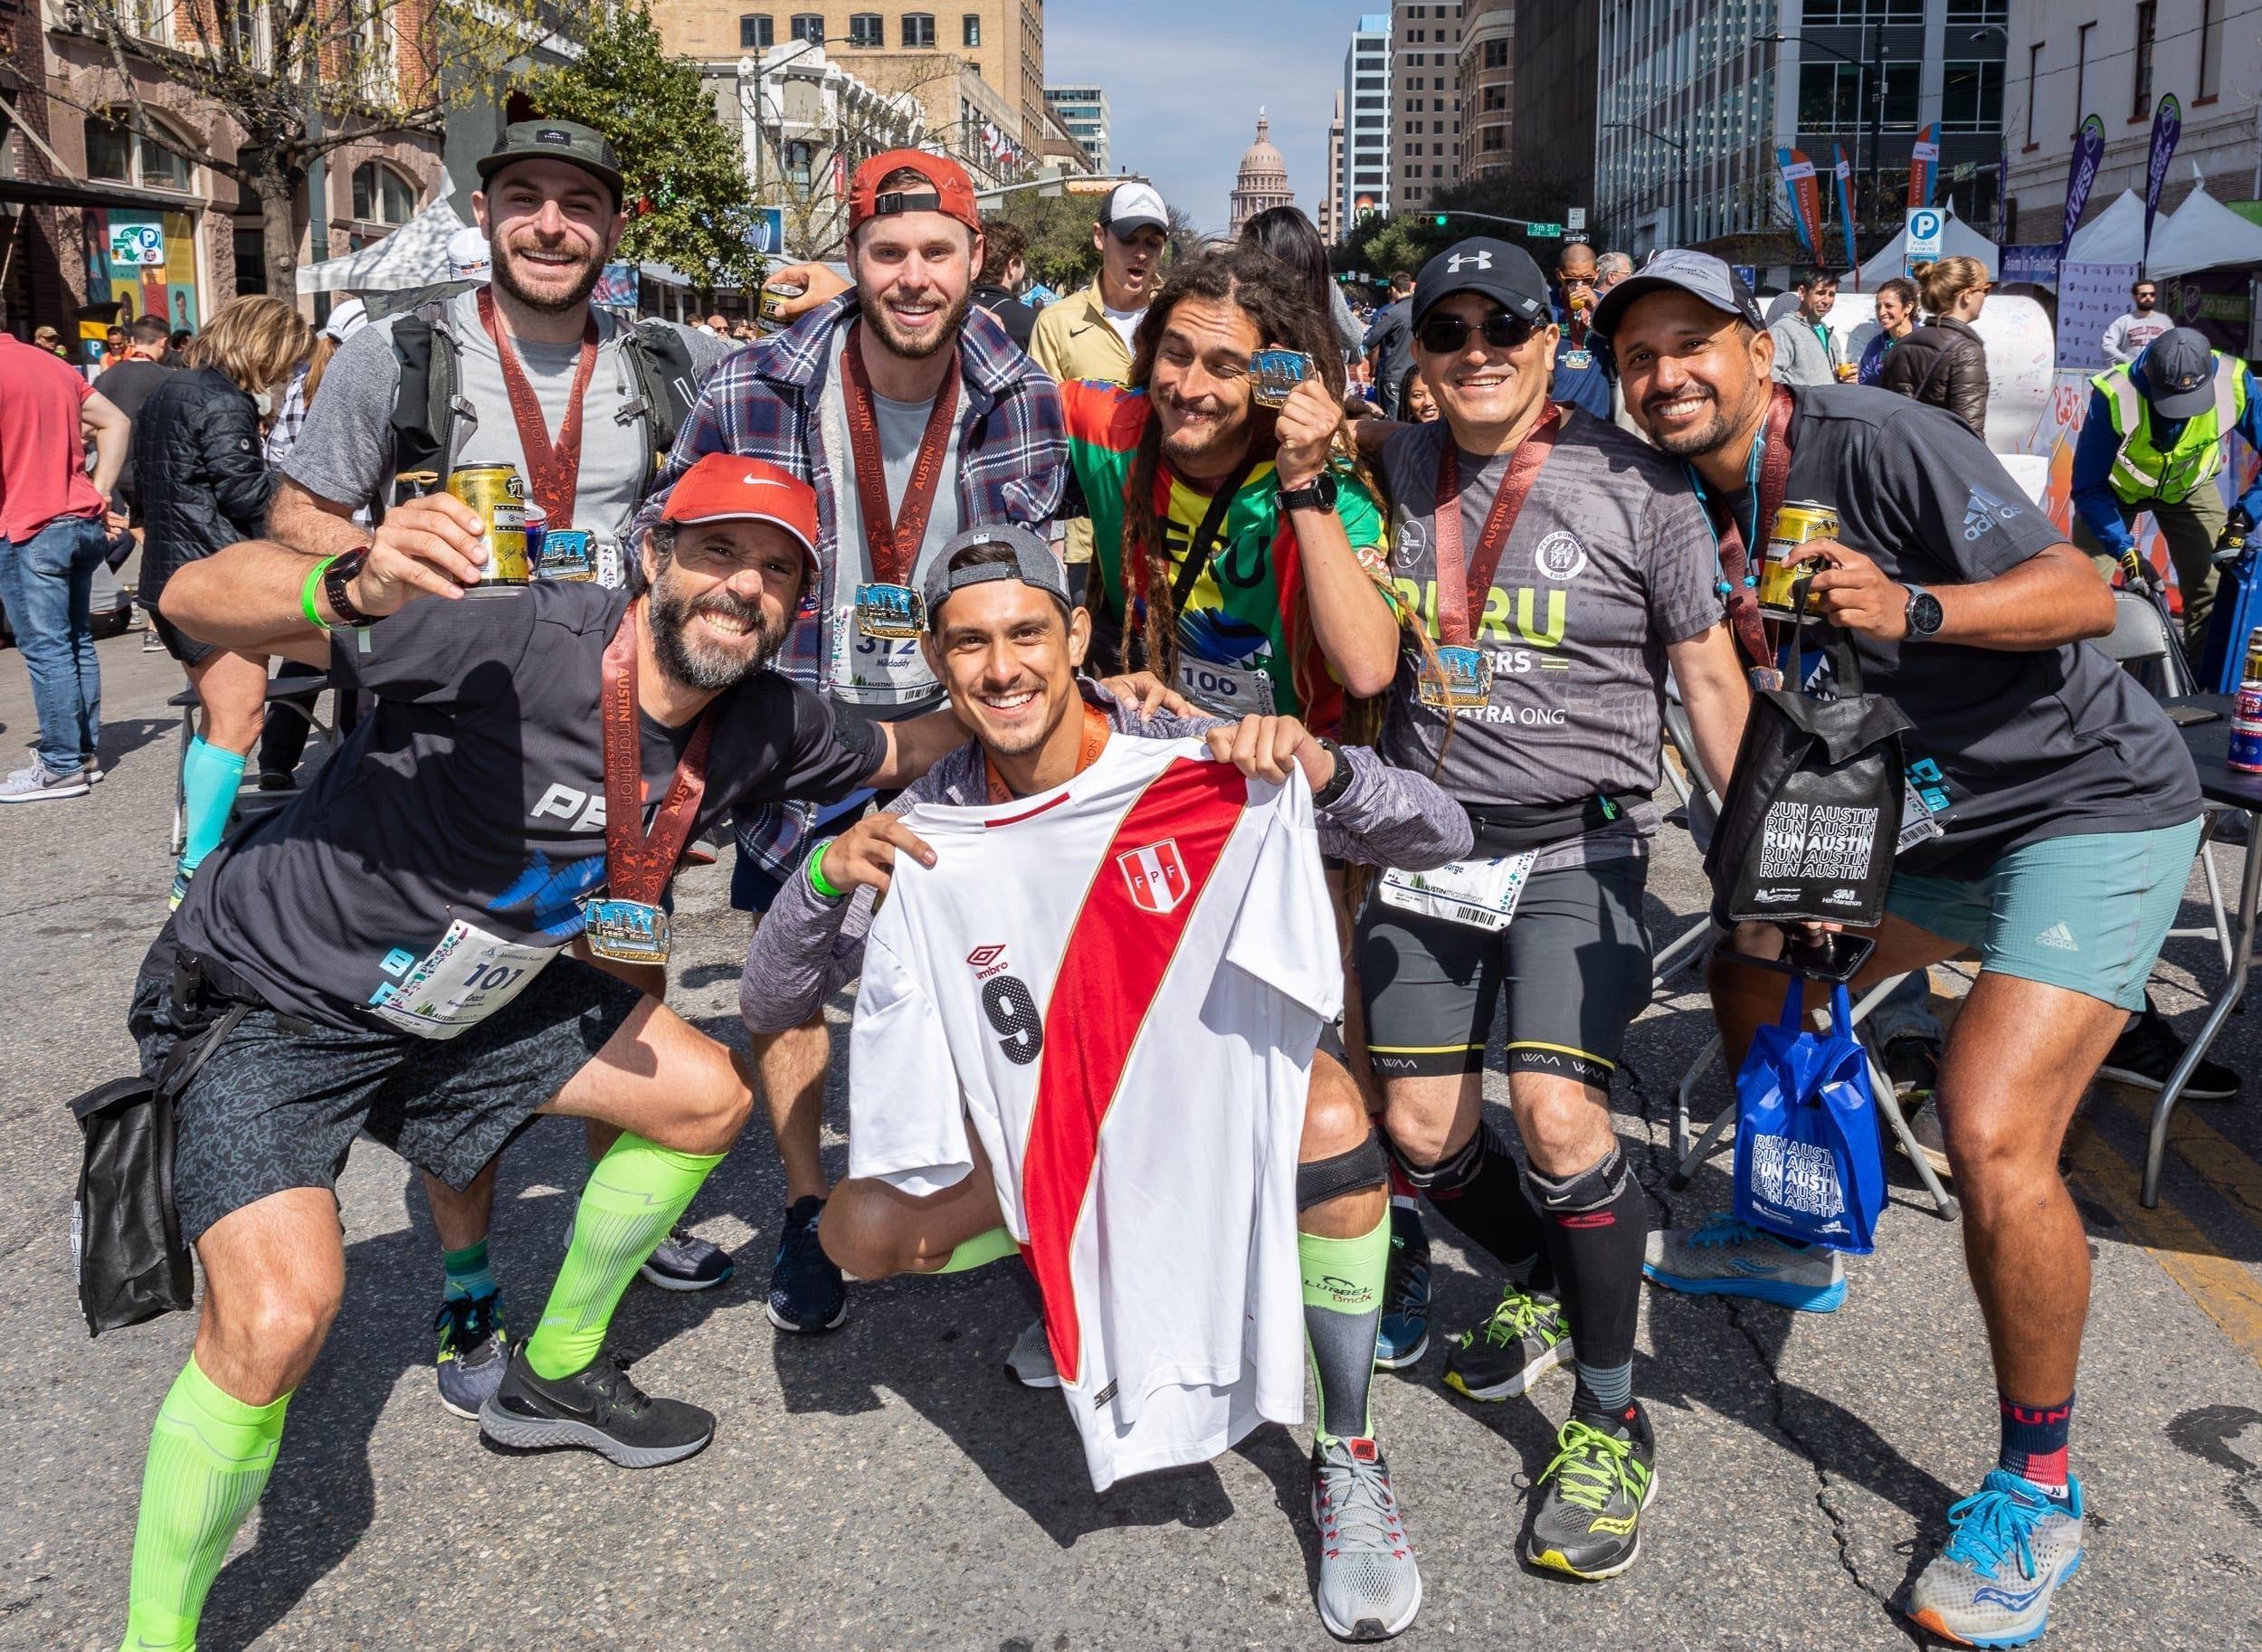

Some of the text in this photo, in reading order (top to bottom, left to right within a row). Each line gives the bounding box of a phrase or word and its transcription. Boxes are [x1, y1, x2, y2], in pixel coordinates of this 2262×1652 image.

[794, 52, 814, 65] 1892
[1915, 164, 1923, 200] VISION
[1800, 181, 1811, 205] TEAM
[2066, 161, 2095, 235] LIVES!
[1534, 223, 1554, 233] 5th ST
[2003, 255, 2021, 271] Team
[2028, 255, 2058, 274] Training
[2201, 299, 2246, 315] GO TEAM!
[509, 382, 527, 428] FINISHER
[855, 386, 883, 503] AUSTINmarathon
[914, 384, 952, 490] AUSTINmaratho
[1483, 441, 1536, 549] AUSTINmaratho
[1963, 504, 2023, 541] adias
[856, 635, 917, 655] 312
[1183, 668, 1238, 696] 100
[1520, 707, 1566, 725] ONG
[604, 694, 615, 782] 2019 FINISHER
[616, 667, 637, 807] AUSTINmarathon
[1767, 802, 1878, 824] RUN AUSTIN
[1765, 817, 1876, 838] RUN AUSTIN
[1763, 831, 1873, 852] RUN AUSTIN
[1762, 847, 1871, 866] RUN AUSTIN
[1760, 862, 1868, 879] RUN AUSTIN
[1424, 884, 1484, 904] AUSTINmarathon
[1833, 889, 1855, 901] 3M
[2035, 936, 2078, 951] adidas
[463, 963, 525, 991] 101
[976, 961, 1009, 980] umbro
[982, 975, 1043, 1066] 9
[1753, 1147, 1784, 1166] RUN
[1754, 1134, 1831, 1163] RUN AUST
[1752, 1158, 1783, 1179] RUN
[1752, 1168, 1782, 1192] RUN
[1752, 1181, 1782, 1204] RUN
[1354, 1445, 1373, 1457] NIKE
